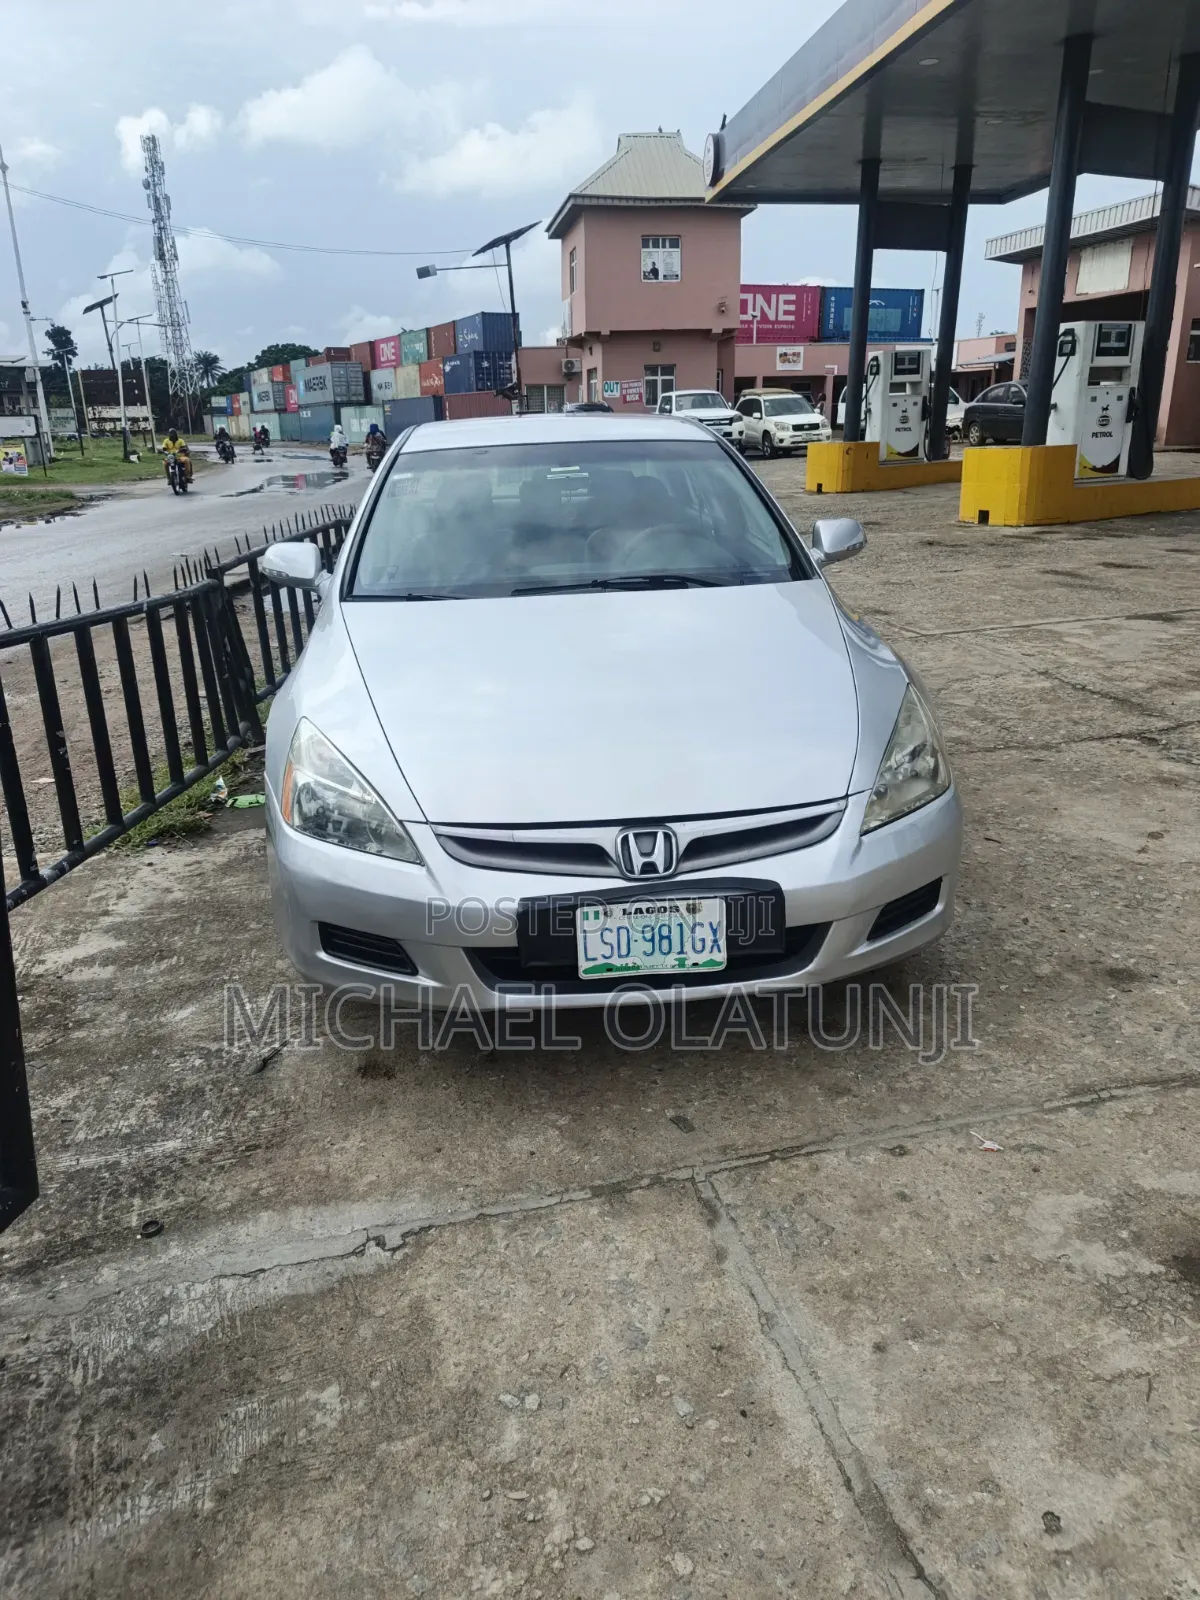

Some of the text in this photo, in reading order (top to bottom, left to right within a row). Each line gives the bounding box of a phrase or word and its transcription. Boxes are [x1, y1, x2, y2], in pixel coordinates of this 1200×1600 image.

[380, 342, 396, 361] ONE
[604, 381, 620, 393] OUT
[626, 394, 640, 402] RISK
[622, 905, 681, 916] LAGOS
